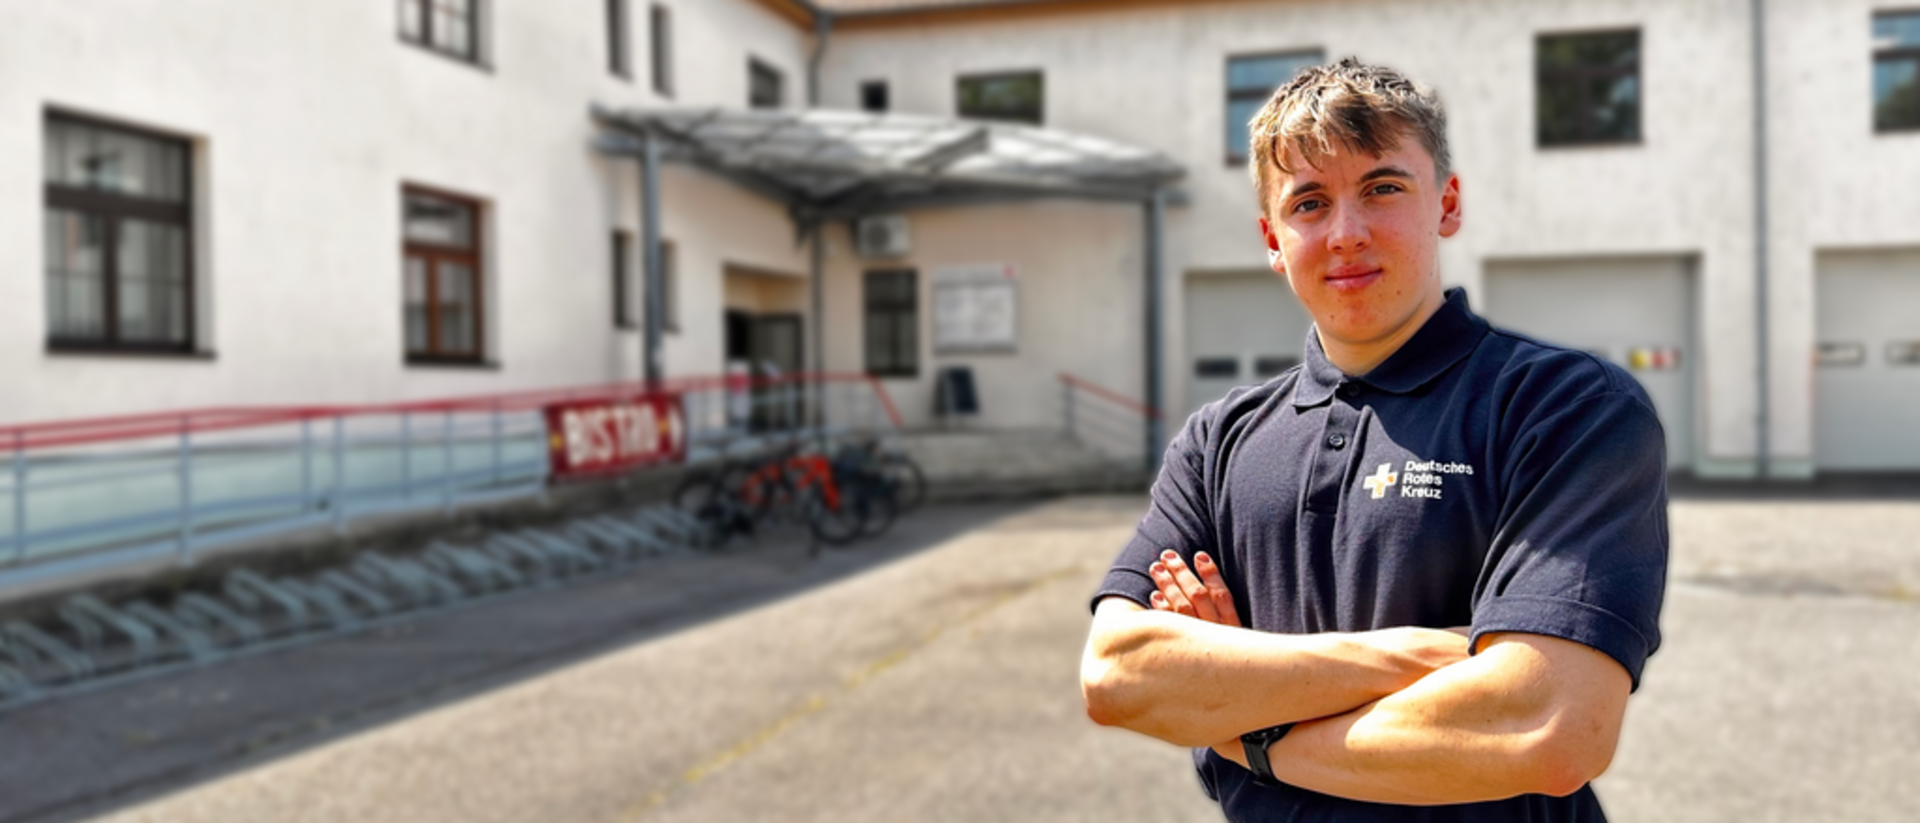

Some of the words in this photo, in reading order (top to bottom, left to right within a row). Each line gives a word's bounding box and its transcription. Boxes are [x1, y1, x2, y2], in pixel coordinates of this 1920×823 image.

[564, 402, 659, 467] BISTRO
[1404, 460, 1474, 475] Deutsches
[1402, 472, 1443, 486] Rotes
[1401, 485, 1442, 499] Kreuz
